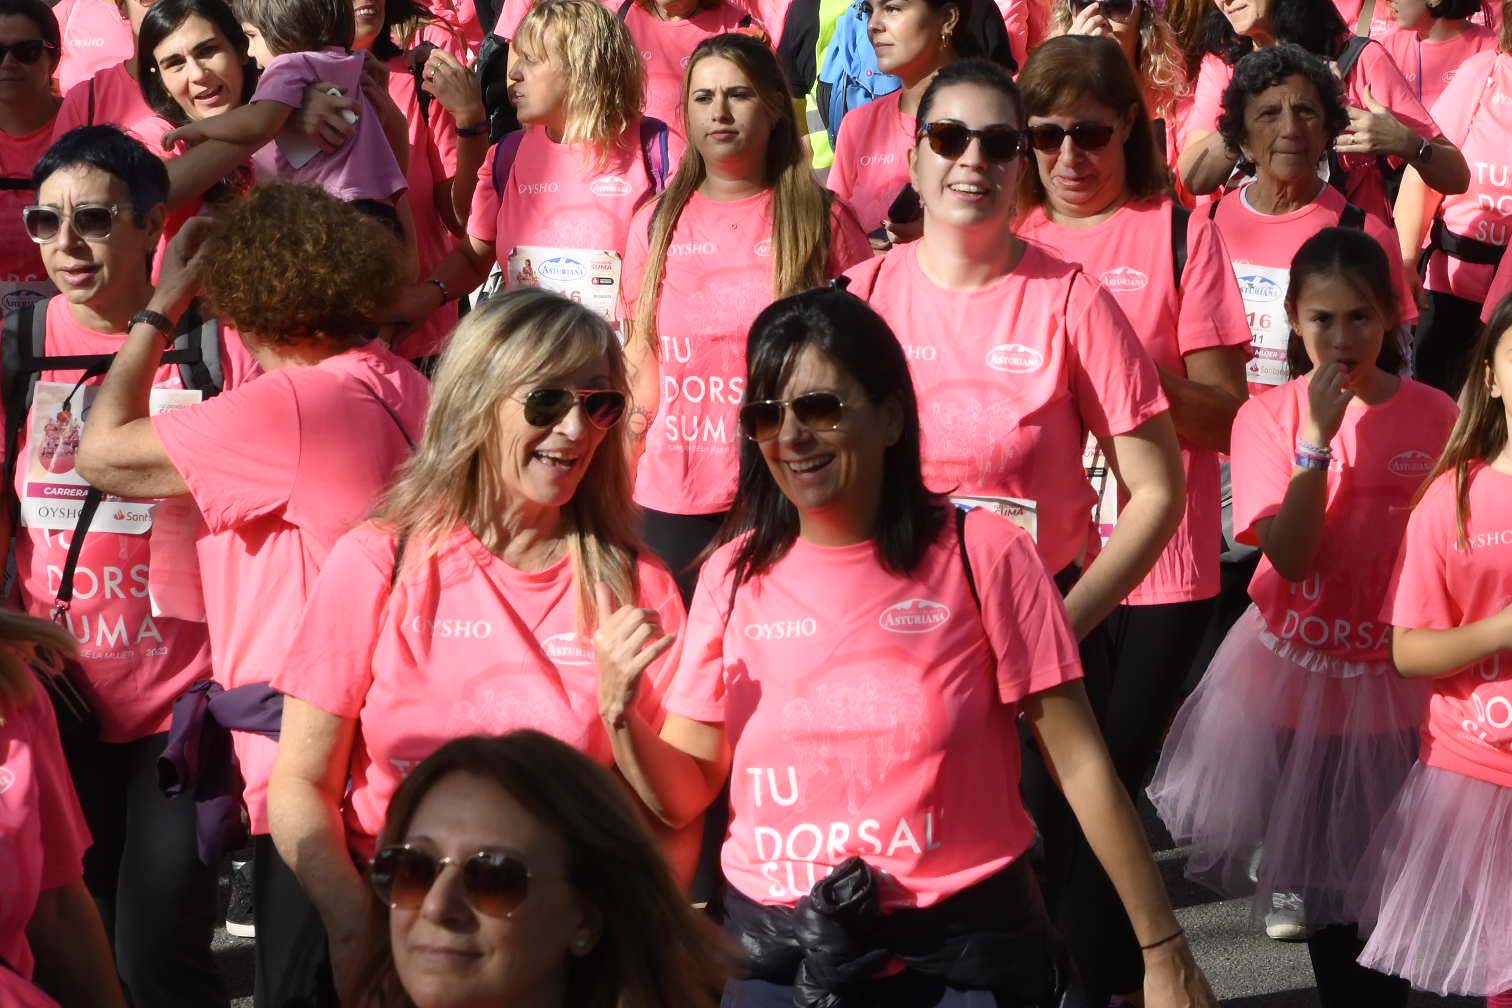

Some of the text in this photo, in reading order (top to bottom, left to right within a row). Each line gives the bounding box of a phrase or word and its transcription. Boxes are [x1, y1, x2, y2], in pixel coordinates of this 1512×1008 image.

[1474, 161, 1508, 187] TU
[542, 265, 584, 276] ASTURIANA
[991, 354, 1041, 367] ASTURIANA
[664, 375, 744, 405] DORS
[44, 487, 89, 497] CARRERA
[47, 564, 150, 600] DORS
[884, 607, 946, 627] ASTURIANA
[744, 618, 817, 641] OYSHO
[746, 765, 799, 808] TU
[755, 810, 942, 863] DORSAL
